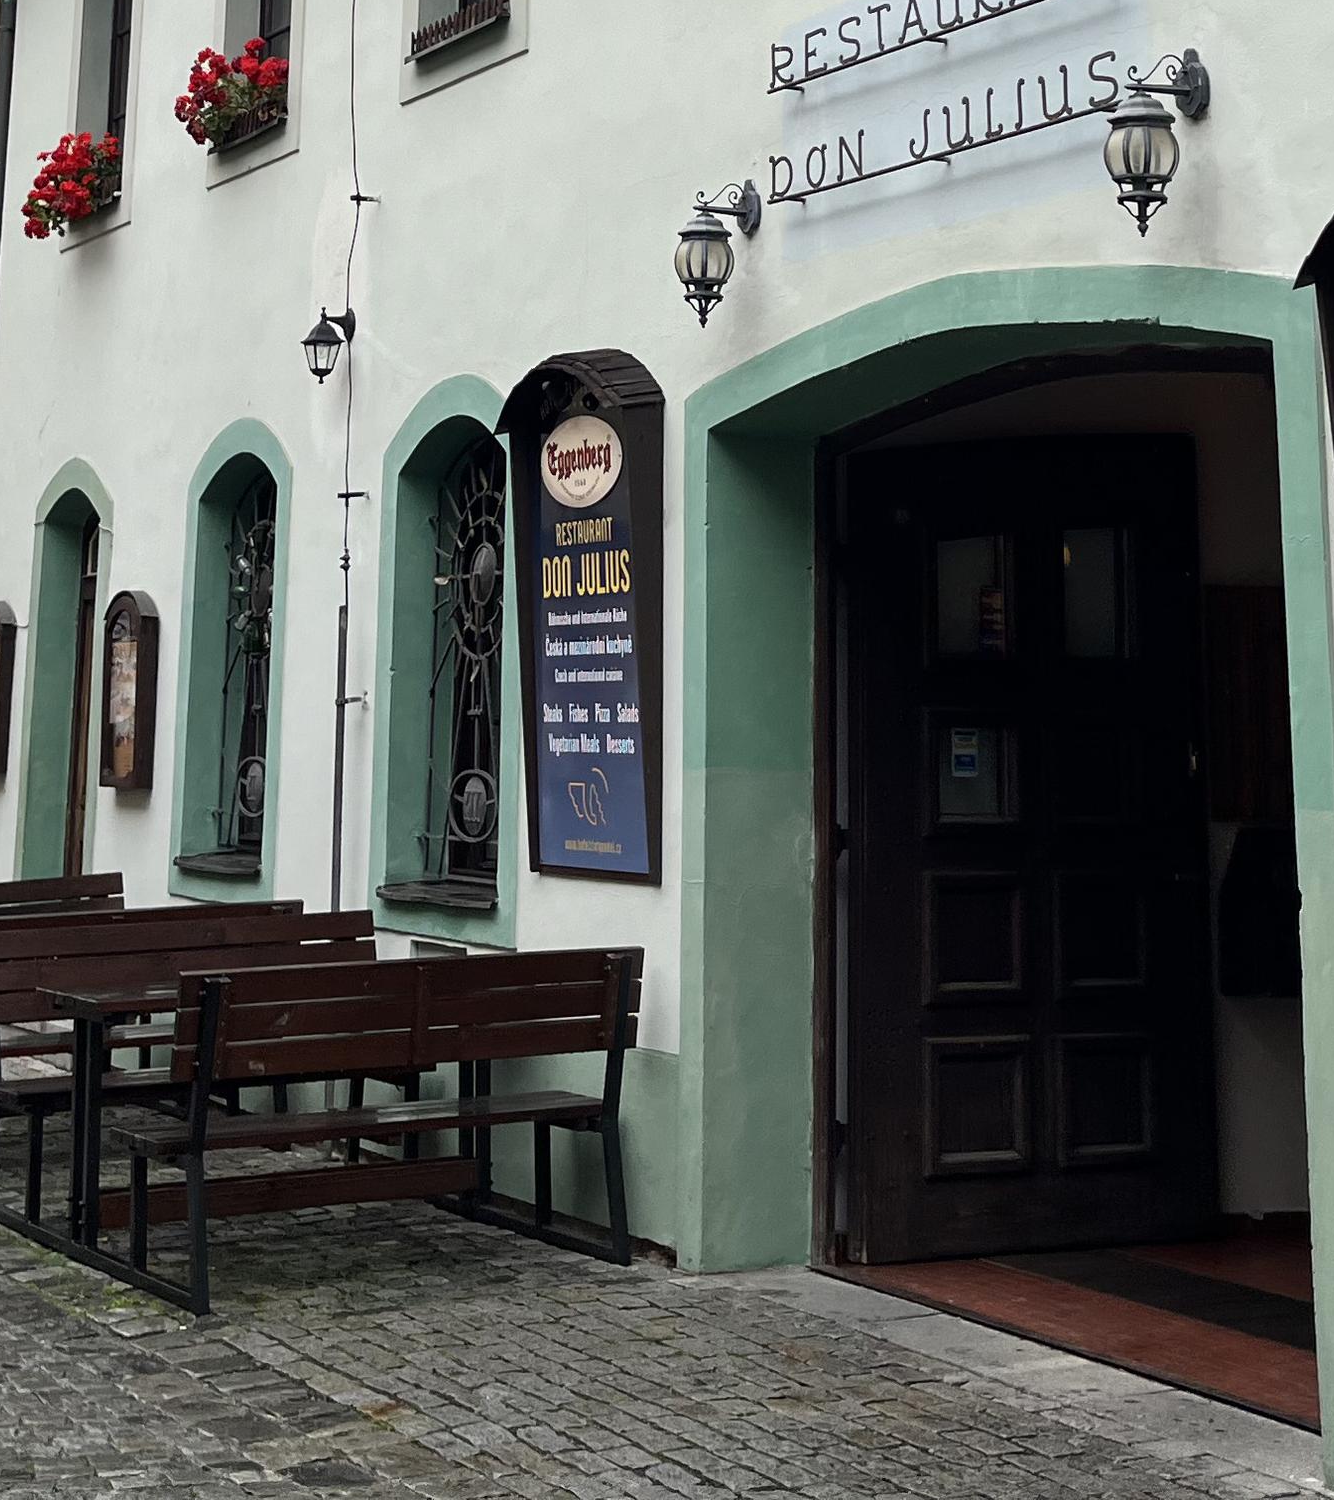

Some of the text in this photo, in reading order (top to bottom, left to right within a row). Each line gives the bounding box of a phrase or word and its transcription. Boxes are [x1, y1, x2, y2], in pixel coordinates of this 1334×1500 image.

[769, 50, 1120, 201] DON JULIUS
[547, 438, 612, 481] Eggenberg
[555, 516, 613, 547] RESTAURANT
[542, 548, 631, 599] DON JULIUS
